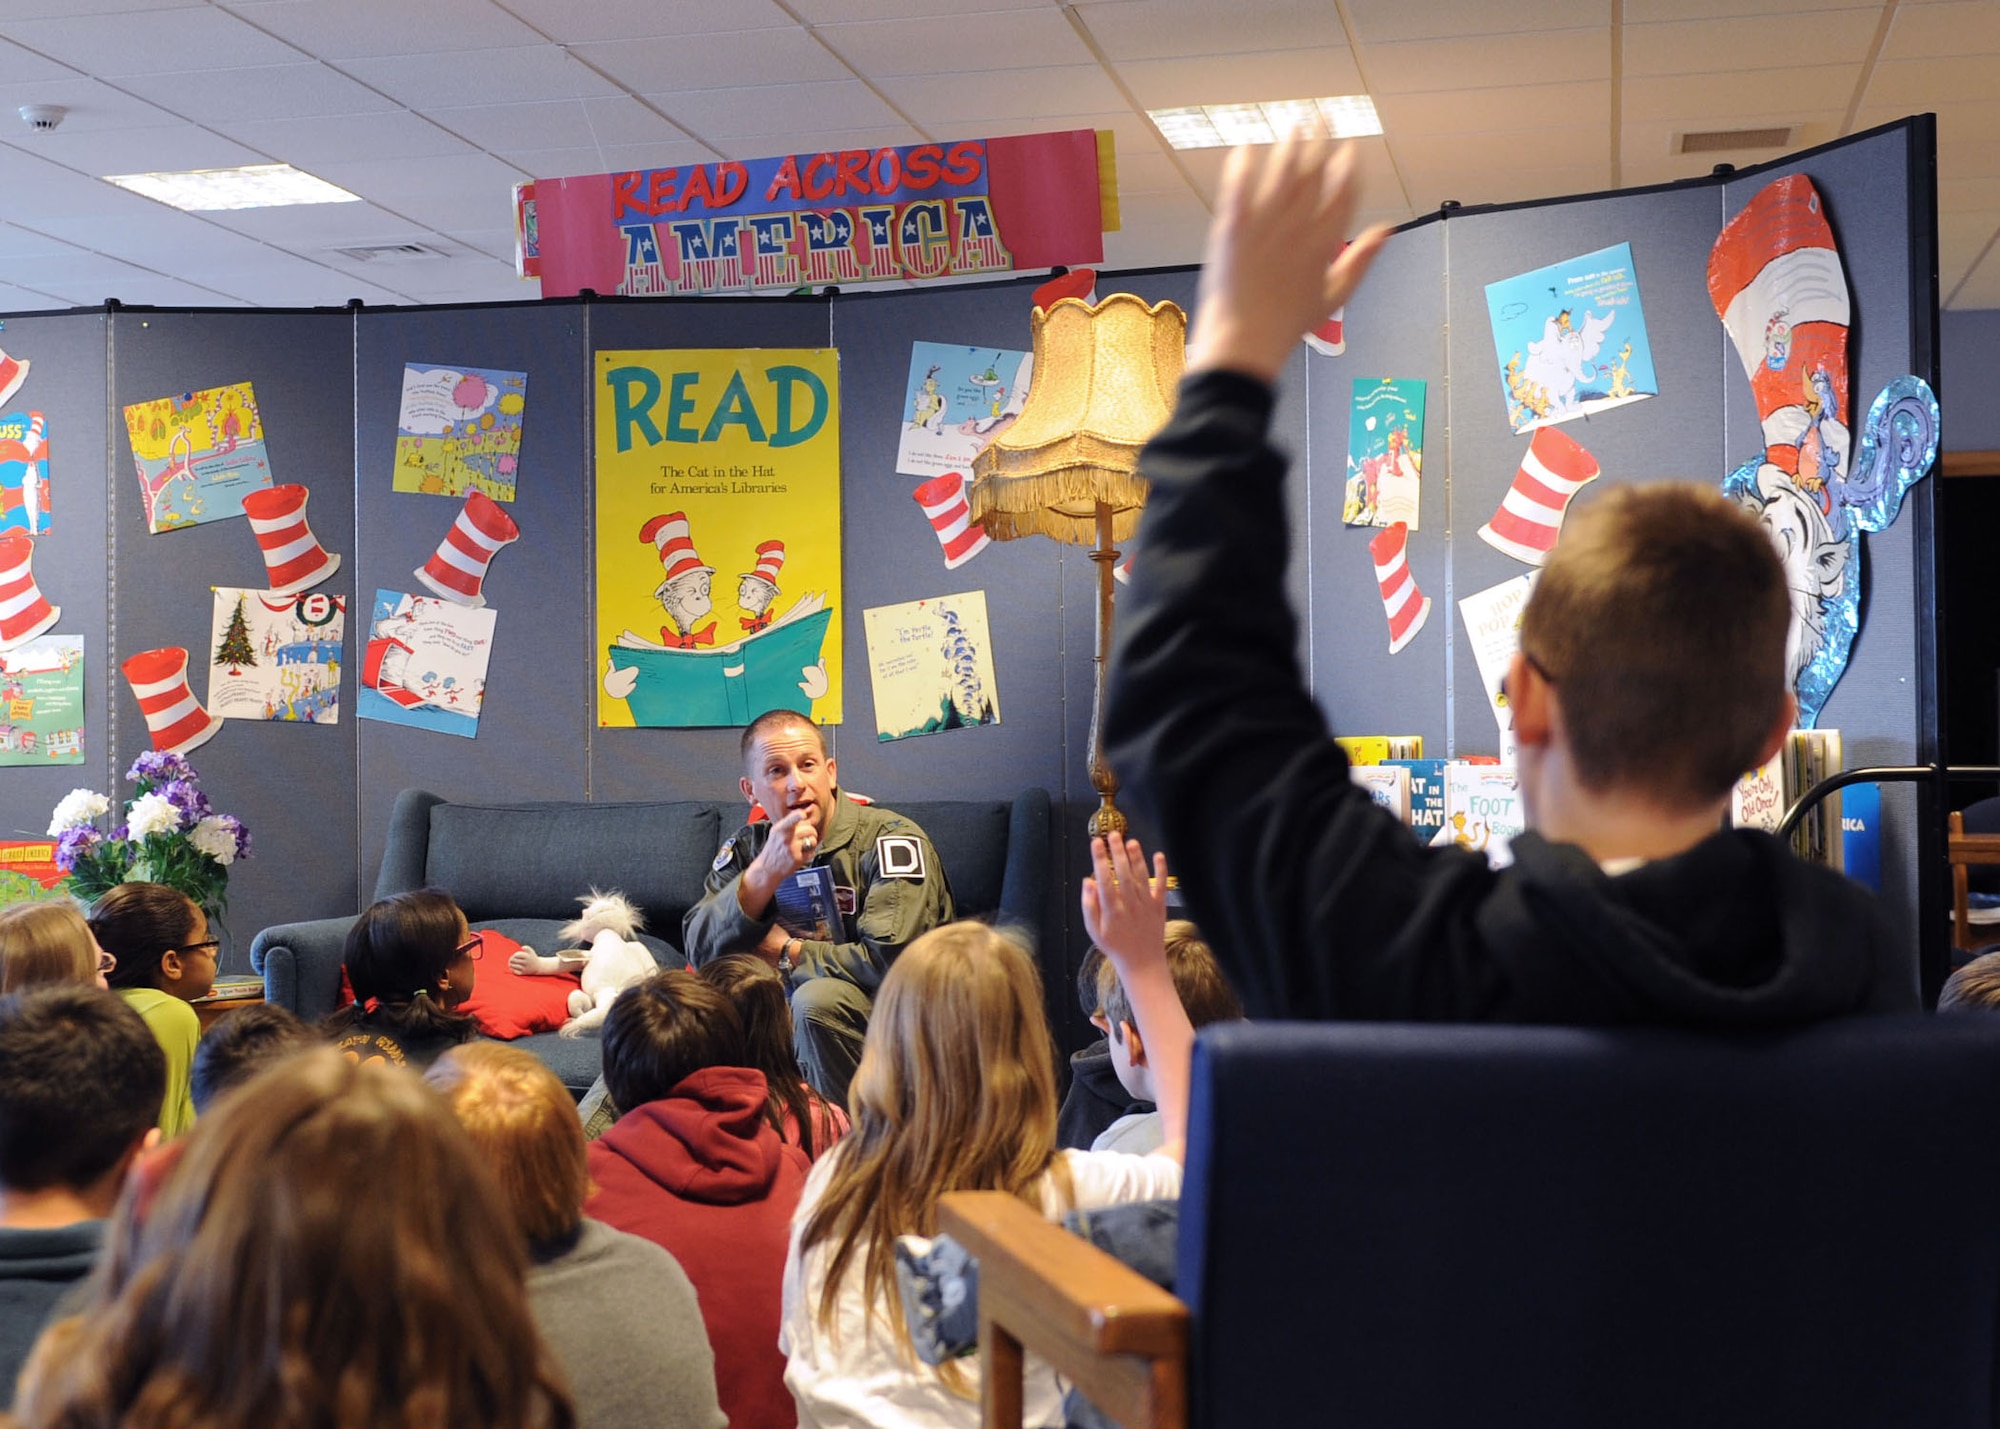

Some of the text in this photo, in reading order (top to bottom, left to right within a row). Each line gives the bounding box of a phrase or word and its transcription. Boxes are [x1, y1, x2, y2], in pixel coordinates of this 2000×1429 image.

[613, 140, 986, 218] READ ACROSS
[617, 196, 1014, 297] AMERICA
[606, 365, 829, 454] READ
[660, 466, 776, 478] The Cat in the Hat
[650, 482, 788, 494] for America's Libraries
[1428, 785, 1440, 796] IN
[1424, 798, 1443, 808] THE
[1469, 796, 1516, 817] FOOT
[1411, 809, 1443, 827] HAT
[883, 839, 919, 874] D
